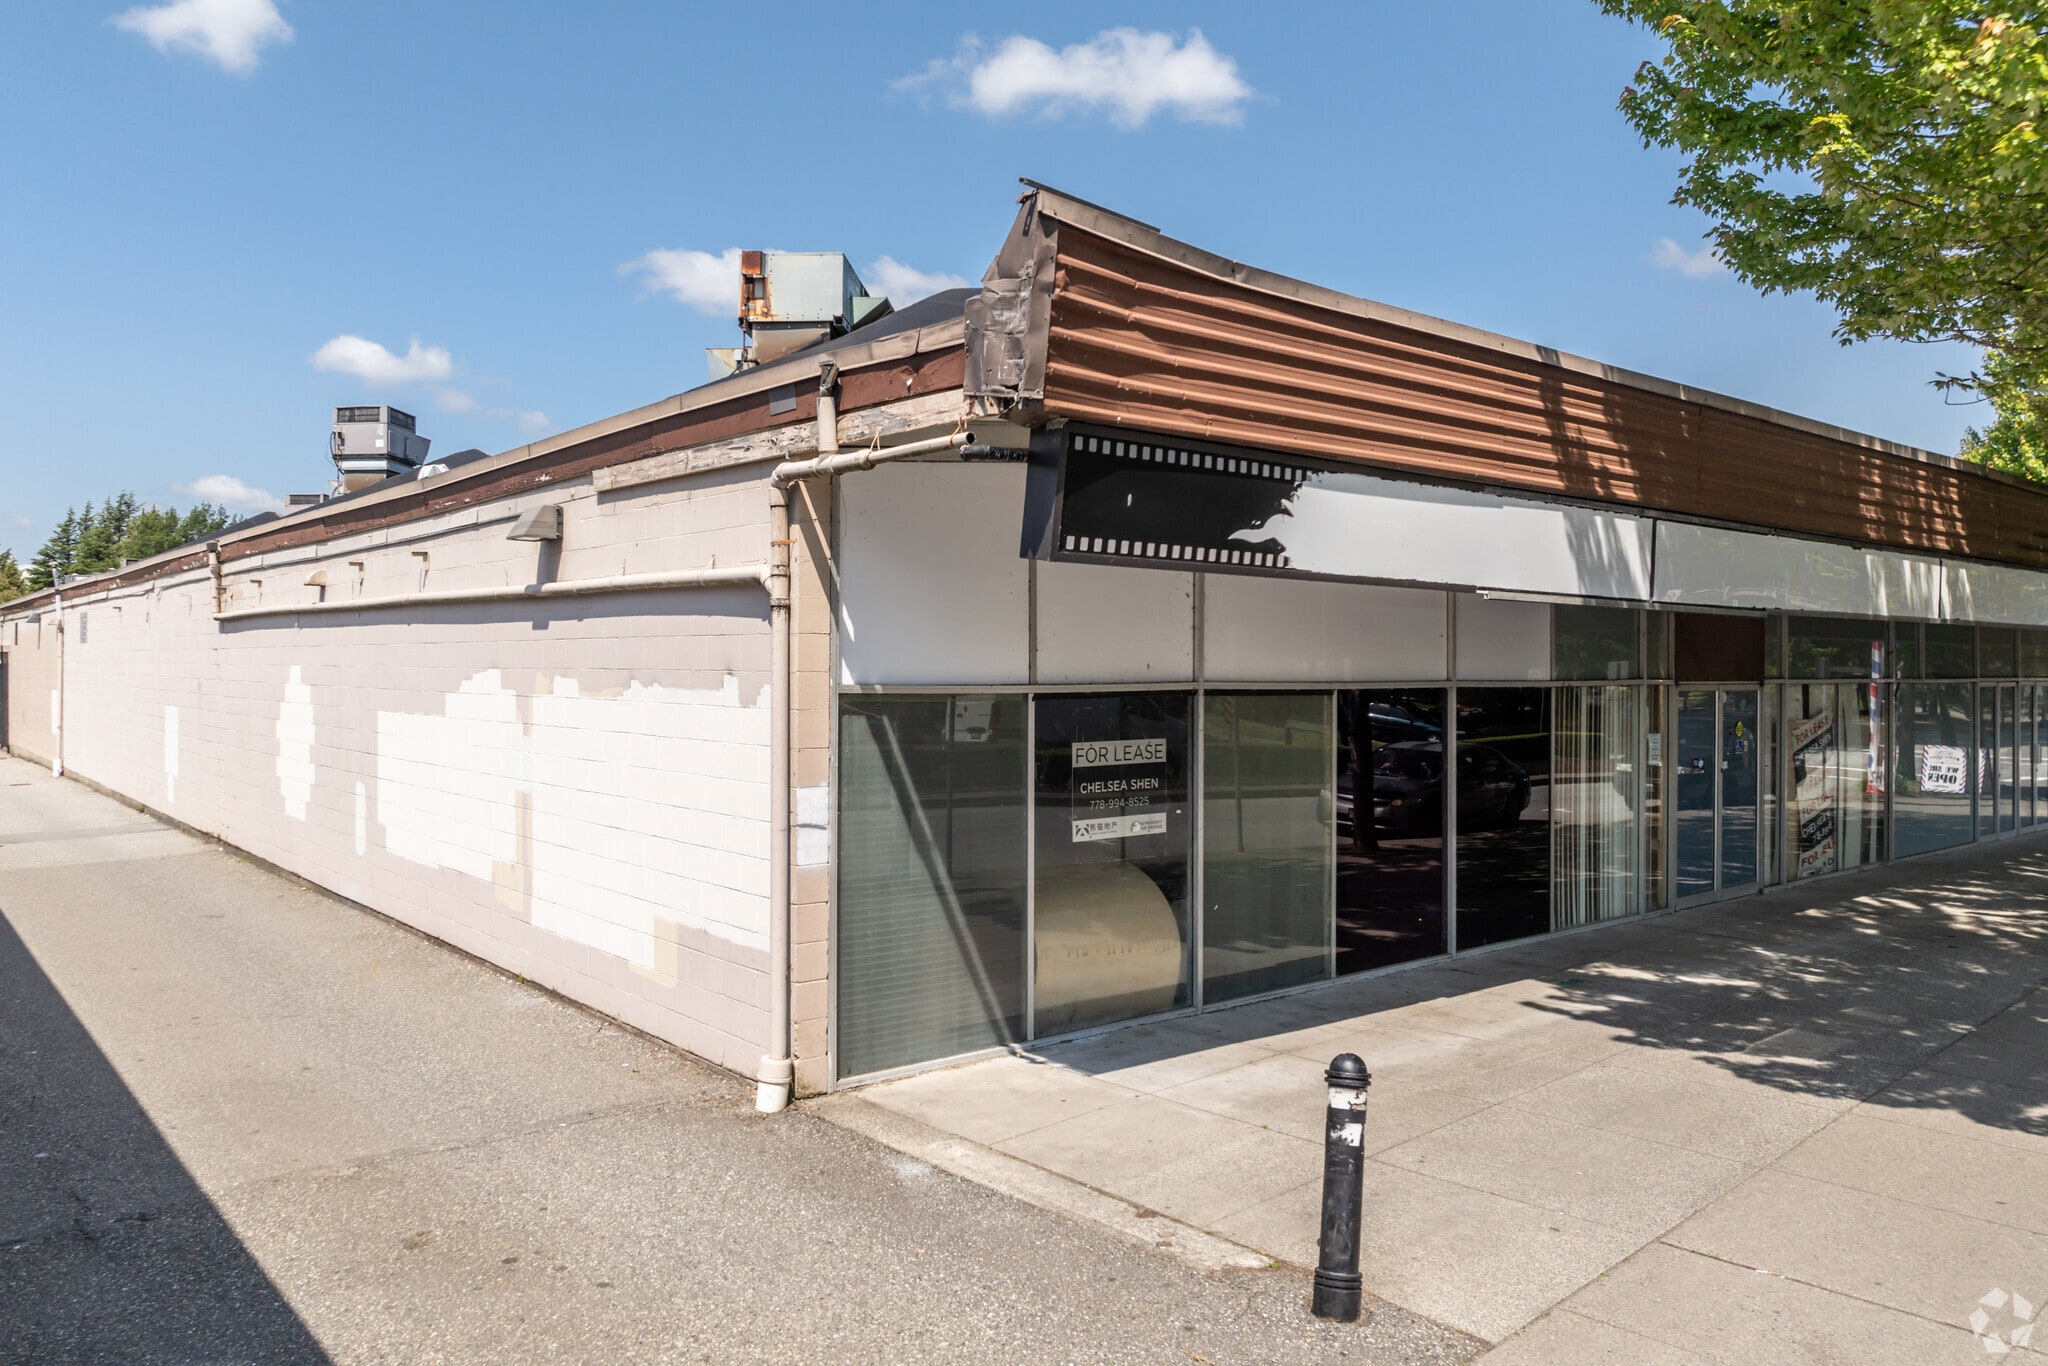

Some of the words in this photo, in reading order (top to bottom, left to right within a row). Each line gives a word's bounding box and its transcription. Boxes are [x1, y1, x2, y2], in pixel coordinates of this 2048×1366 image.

[1075, 746, 1109, 764] FOR
[1114, 743, 1164, 762] LEASE
[1080, 781, 1128, 794] CHELSEA
[1130, 778, 1159, 790] SHEN
[1089, 796, 1150, 811] 778-994-8525
